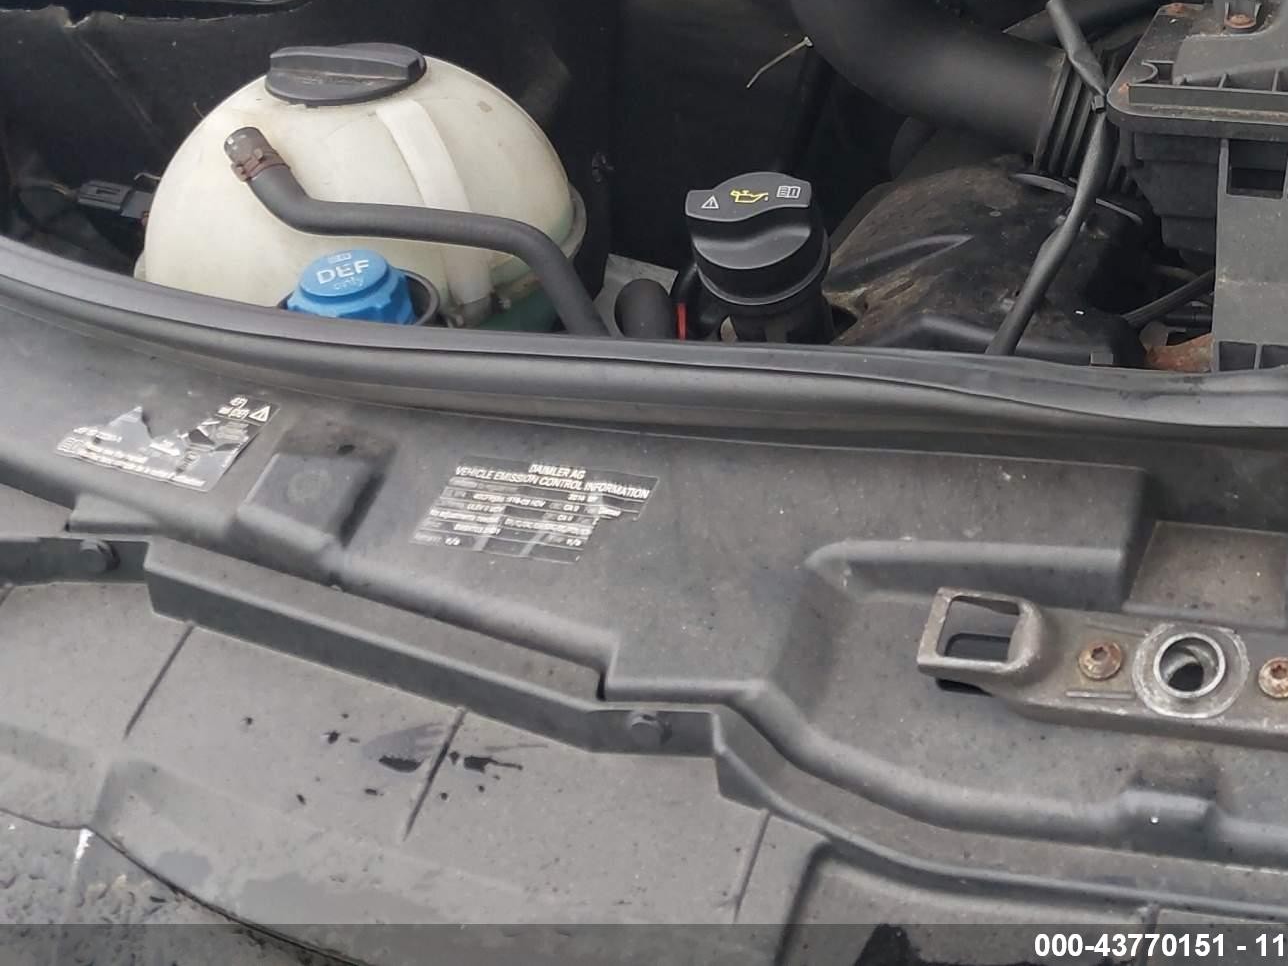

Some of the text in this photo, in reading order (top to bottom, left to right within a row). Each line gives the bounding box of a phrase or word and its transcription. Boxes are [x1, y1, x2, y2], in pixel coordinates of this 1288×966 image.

[316, 260, 369, 284] DEF
[455, 466, 494, 480] VEHICLE
[493, 471, 539, 485] EMISSION
[538, 476, 583, 491] CONTROL
[583, 481, 650, 499] INFORMATION
[528, 464, 586, 480] DAIMLER AG
